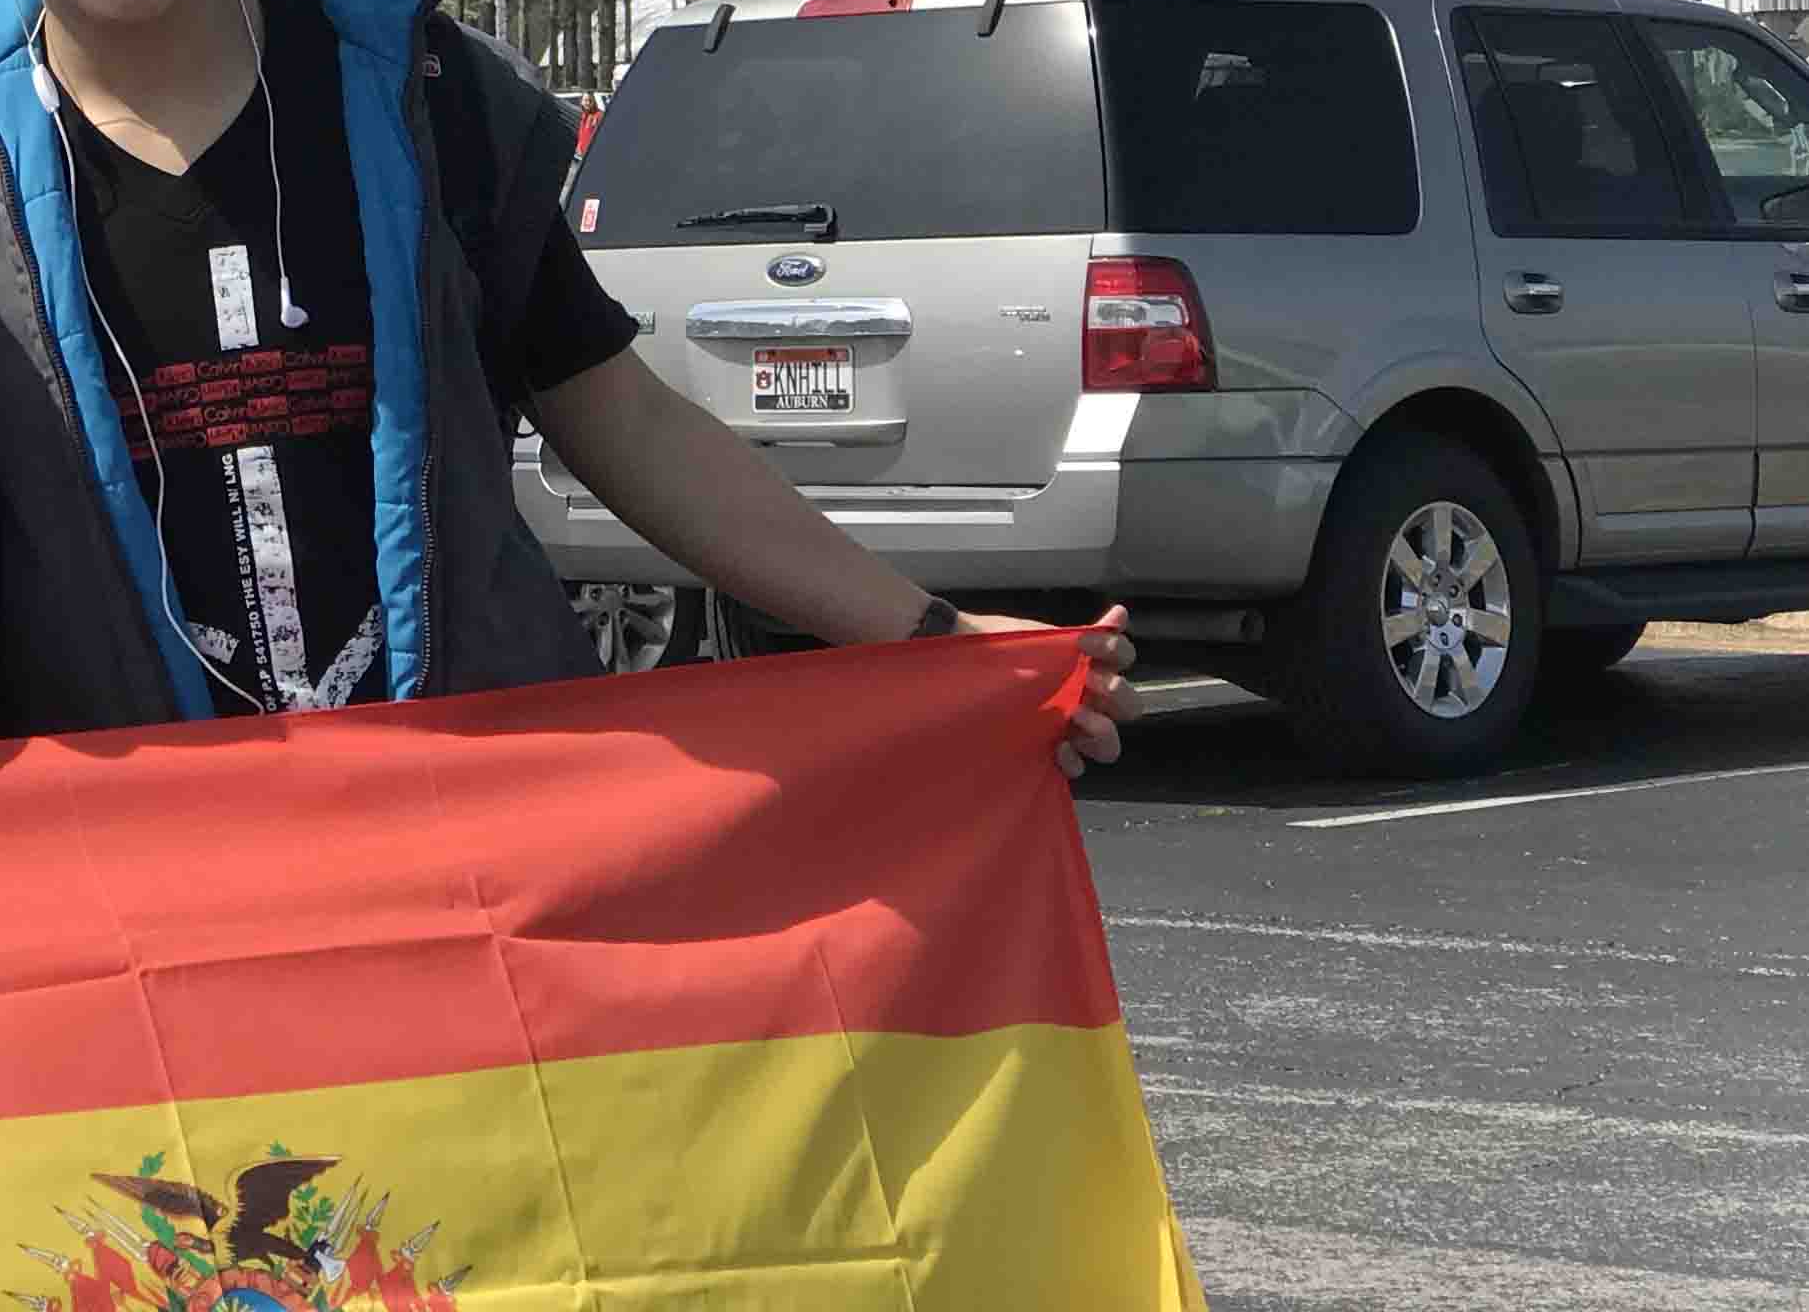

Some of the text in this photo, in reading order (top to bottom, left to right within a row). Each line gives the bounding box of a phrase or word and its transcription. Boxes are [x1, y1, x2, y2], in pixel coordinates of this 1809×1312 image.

[776, 260, 809, 278] Ford
[774, 362, 846, 396] KNHILL
[776, 394, 828, 409] AUBURN
[221, 453, 238, 485] LNG
[231, 506, 247, 543] WILL
[236, 546, 251, 576] ESY
[242, 577, 257, 608] THE
